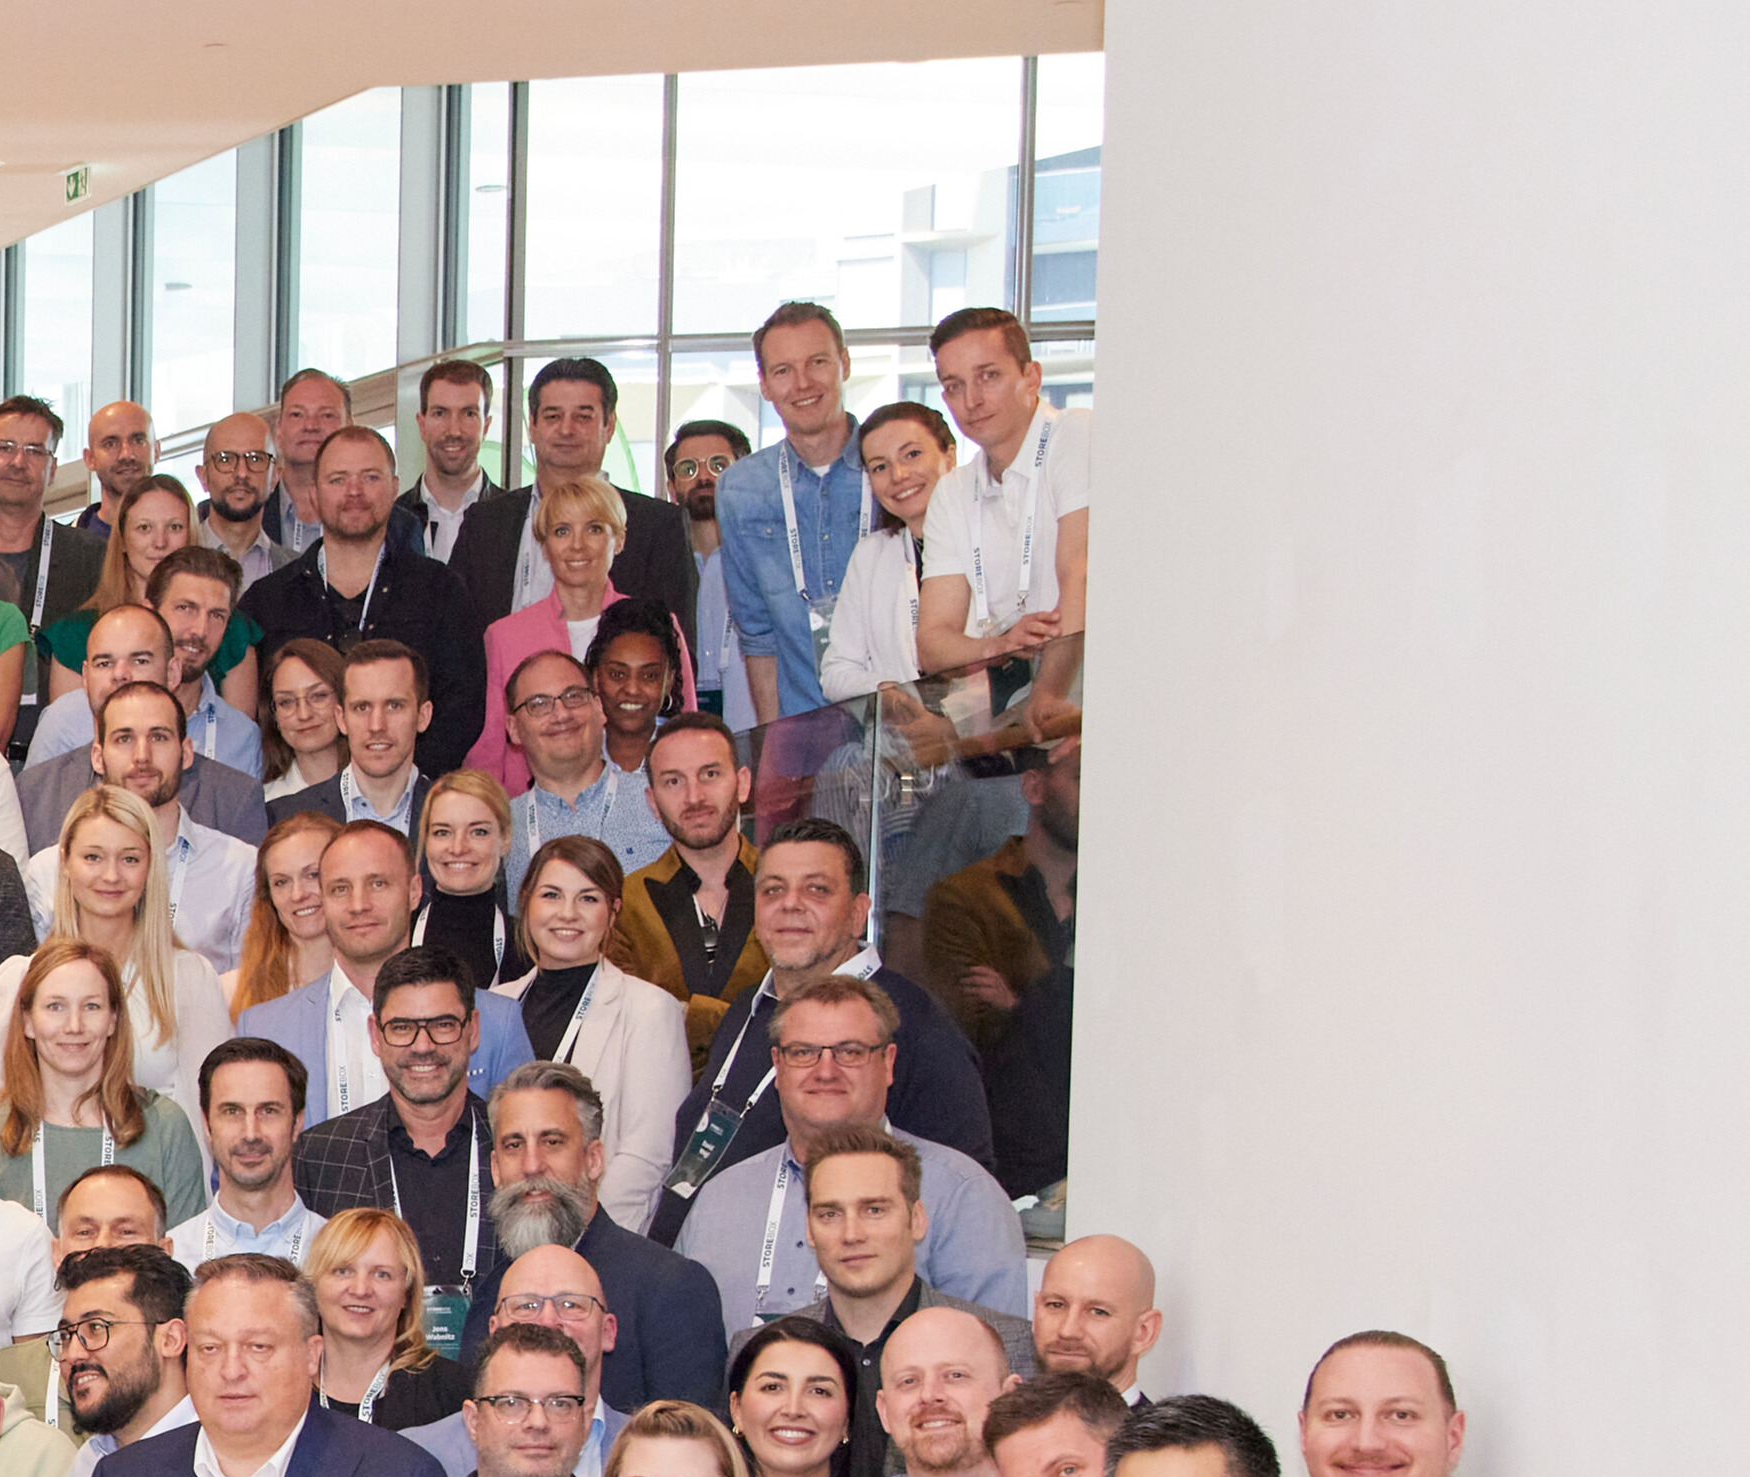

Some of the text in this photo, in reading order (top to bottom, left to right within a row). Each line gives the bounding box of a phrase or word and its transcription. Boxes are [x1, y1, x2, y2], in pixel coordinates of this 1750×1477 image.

[1033, 419, 1053, 468] STOREBOX
[789, 526, 802, 571] STOREBOX
[1021, 514, 1034, 566] STOREBOX
[34, 571, 48, 609] STOREBOX
[973, 546, 985, 596] STOREBOX
[339, 1064, 347, 1113] STOREBOX
[469, 1172, 480, 1218] STOREBOX
[762, 1220, 777, 1269] STOREBOX
[361, 1370, 389, 1420] STOREBOX
